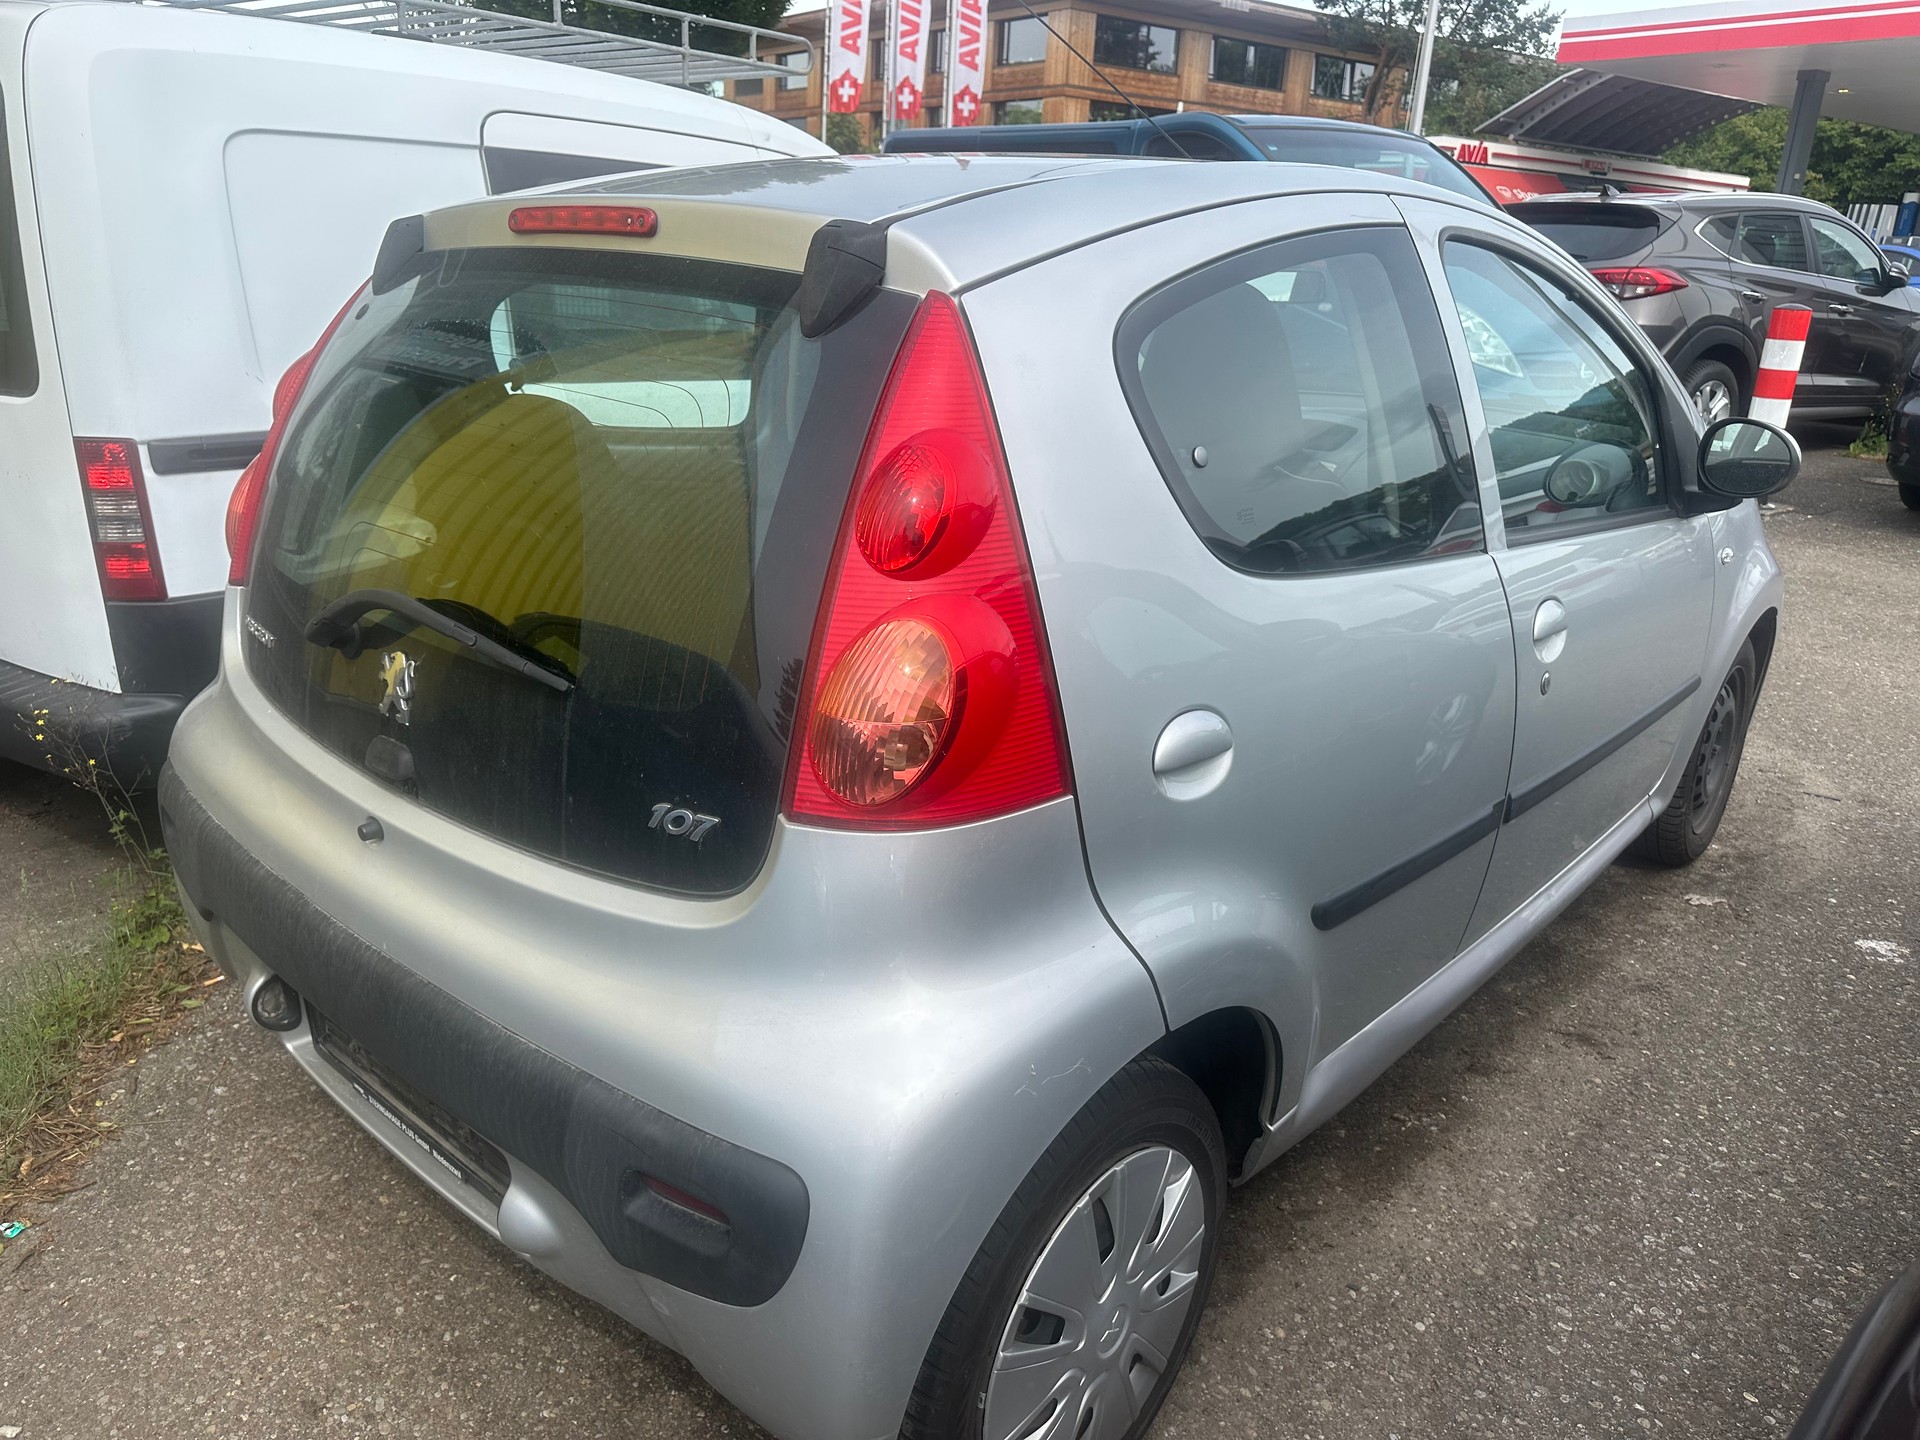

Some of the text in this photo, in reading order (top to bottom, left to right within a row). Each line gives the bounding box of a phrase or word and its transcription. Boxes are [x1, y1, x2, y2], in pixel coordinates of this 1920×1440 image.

[899, 0, 922, 63] AVI
[957, 0, 982, 72] AVIA
[1456, 139, 1489, 165] AVIA
[647, 802, 722, 842] 107
